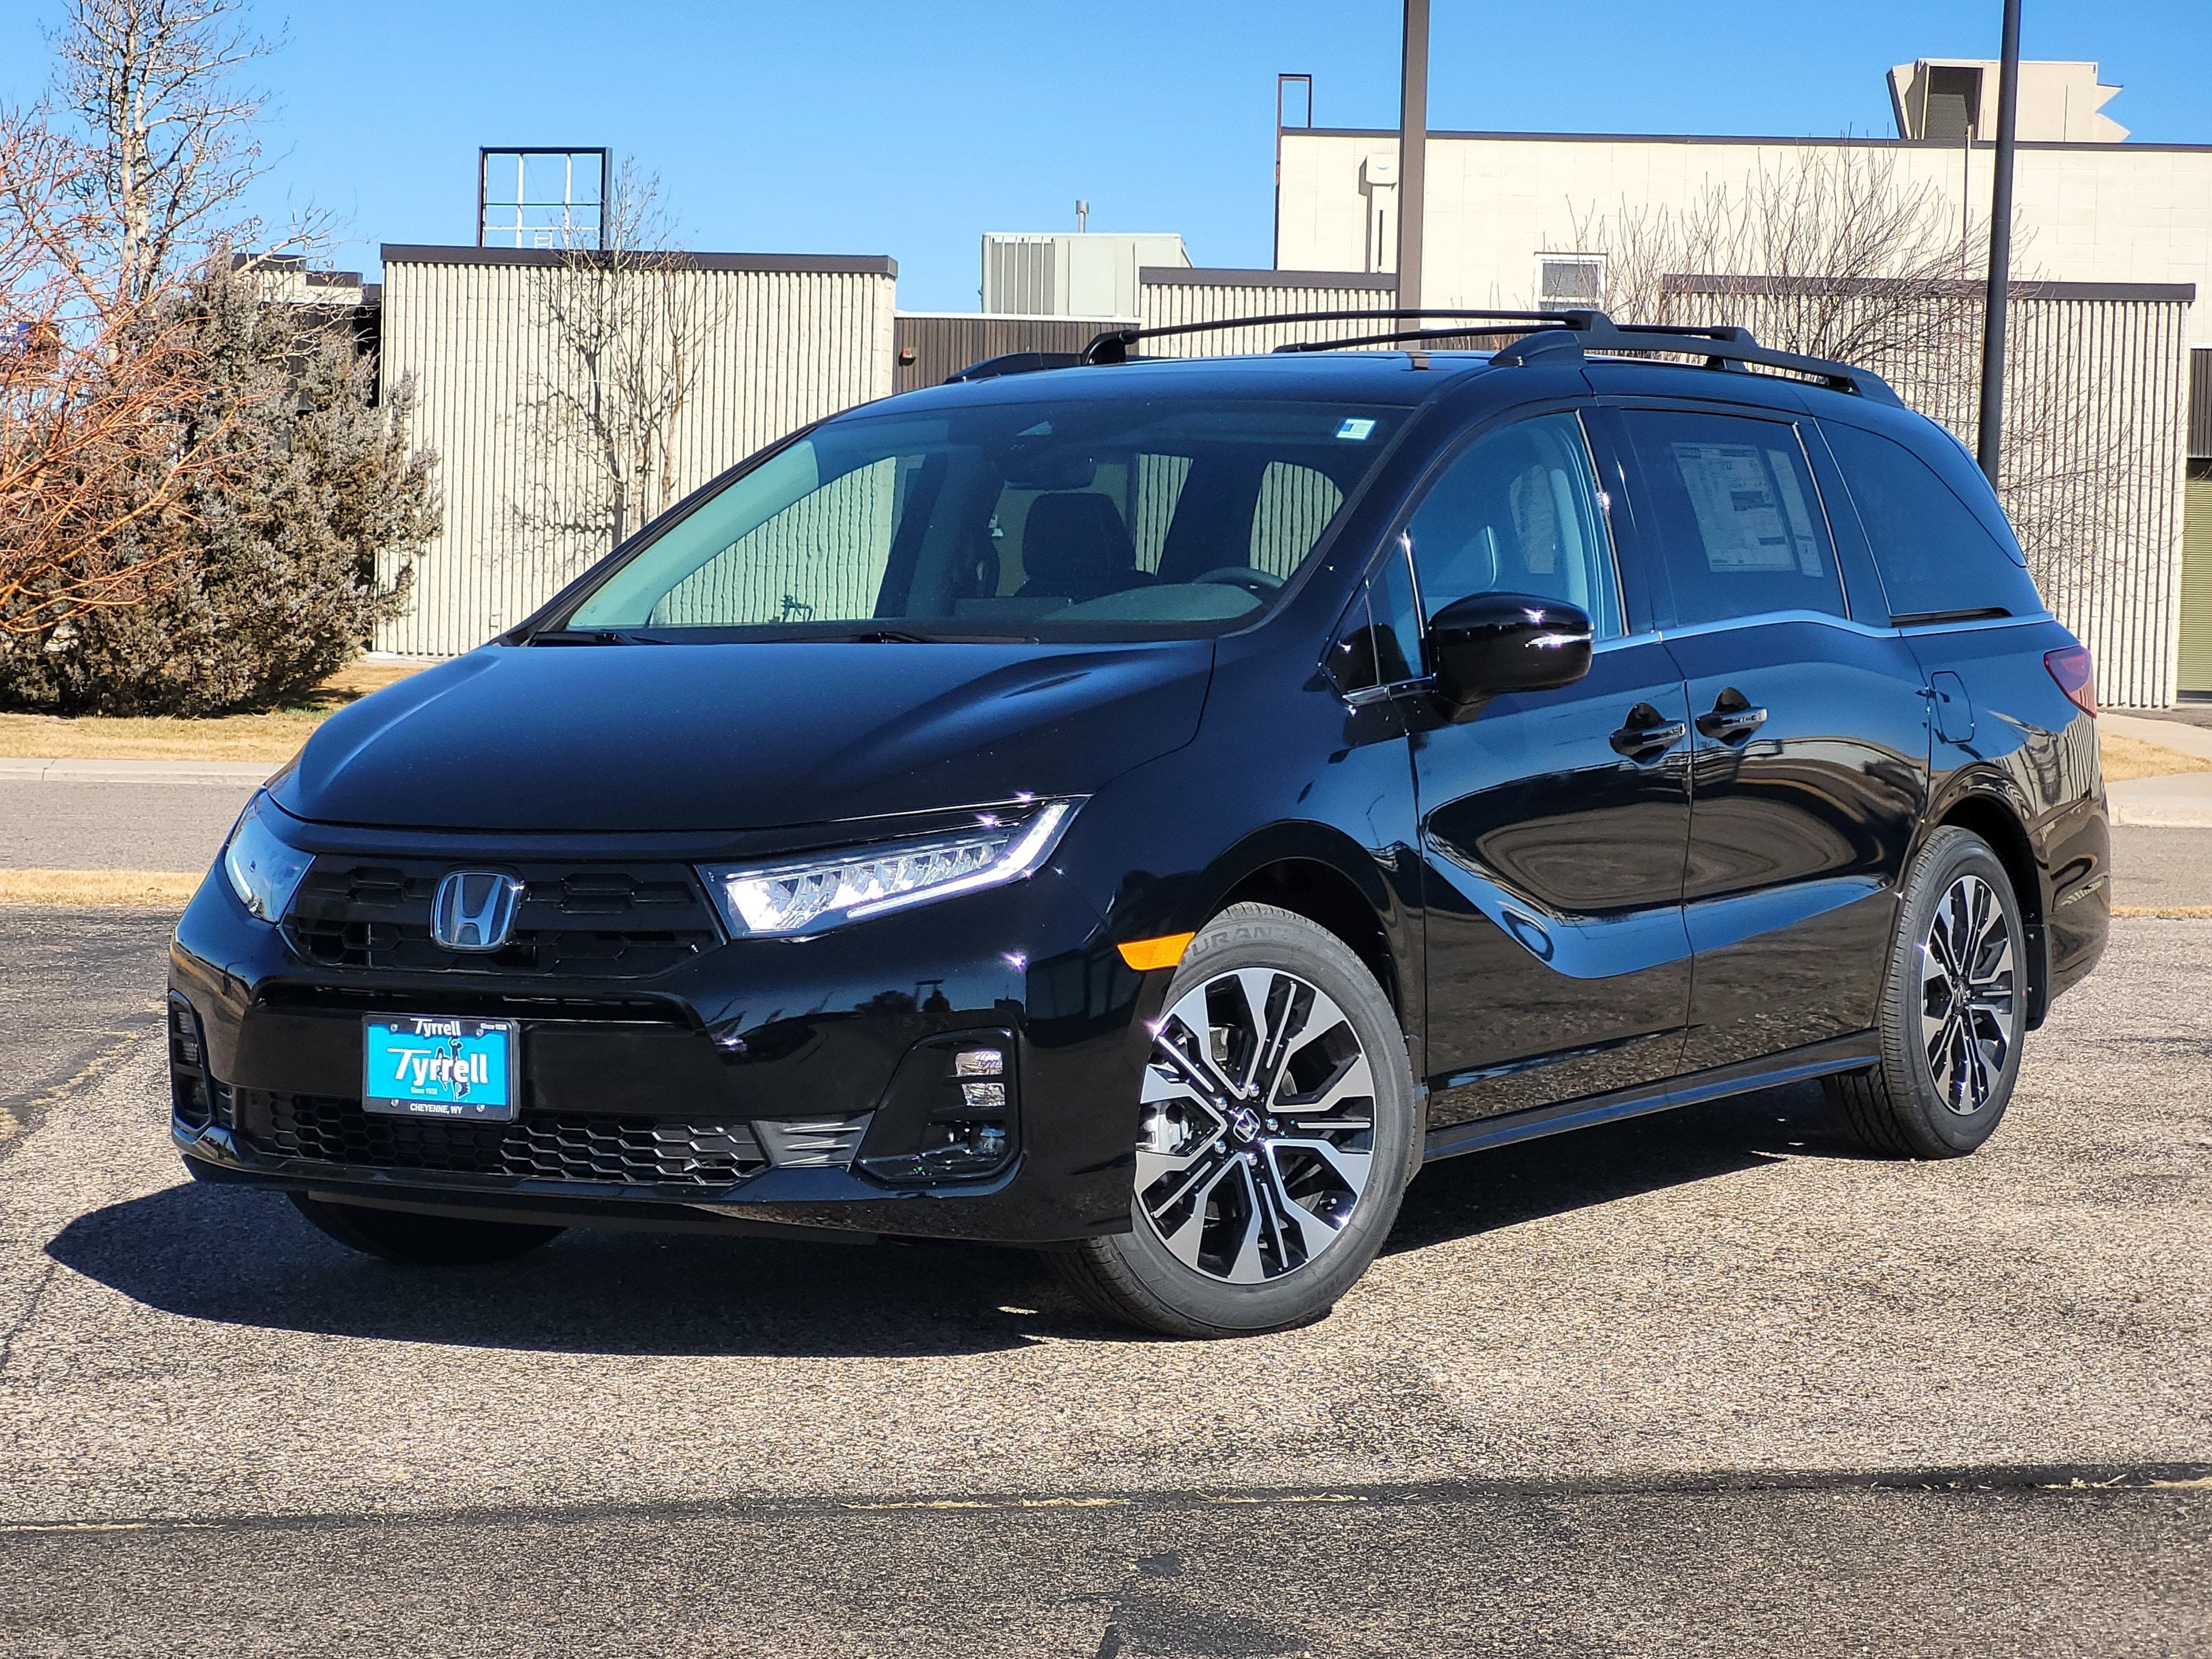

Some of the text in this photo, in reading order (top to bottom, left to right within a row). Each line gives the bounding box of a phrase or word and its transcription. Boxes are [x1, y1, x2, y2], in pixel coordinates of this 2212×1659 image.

[410, 1018, 461, 1037] Tyrrell
[387, 1048, 488, 1086] Tyrrell
[410, 1103, 463, 1115] CHEYENNE, WY
